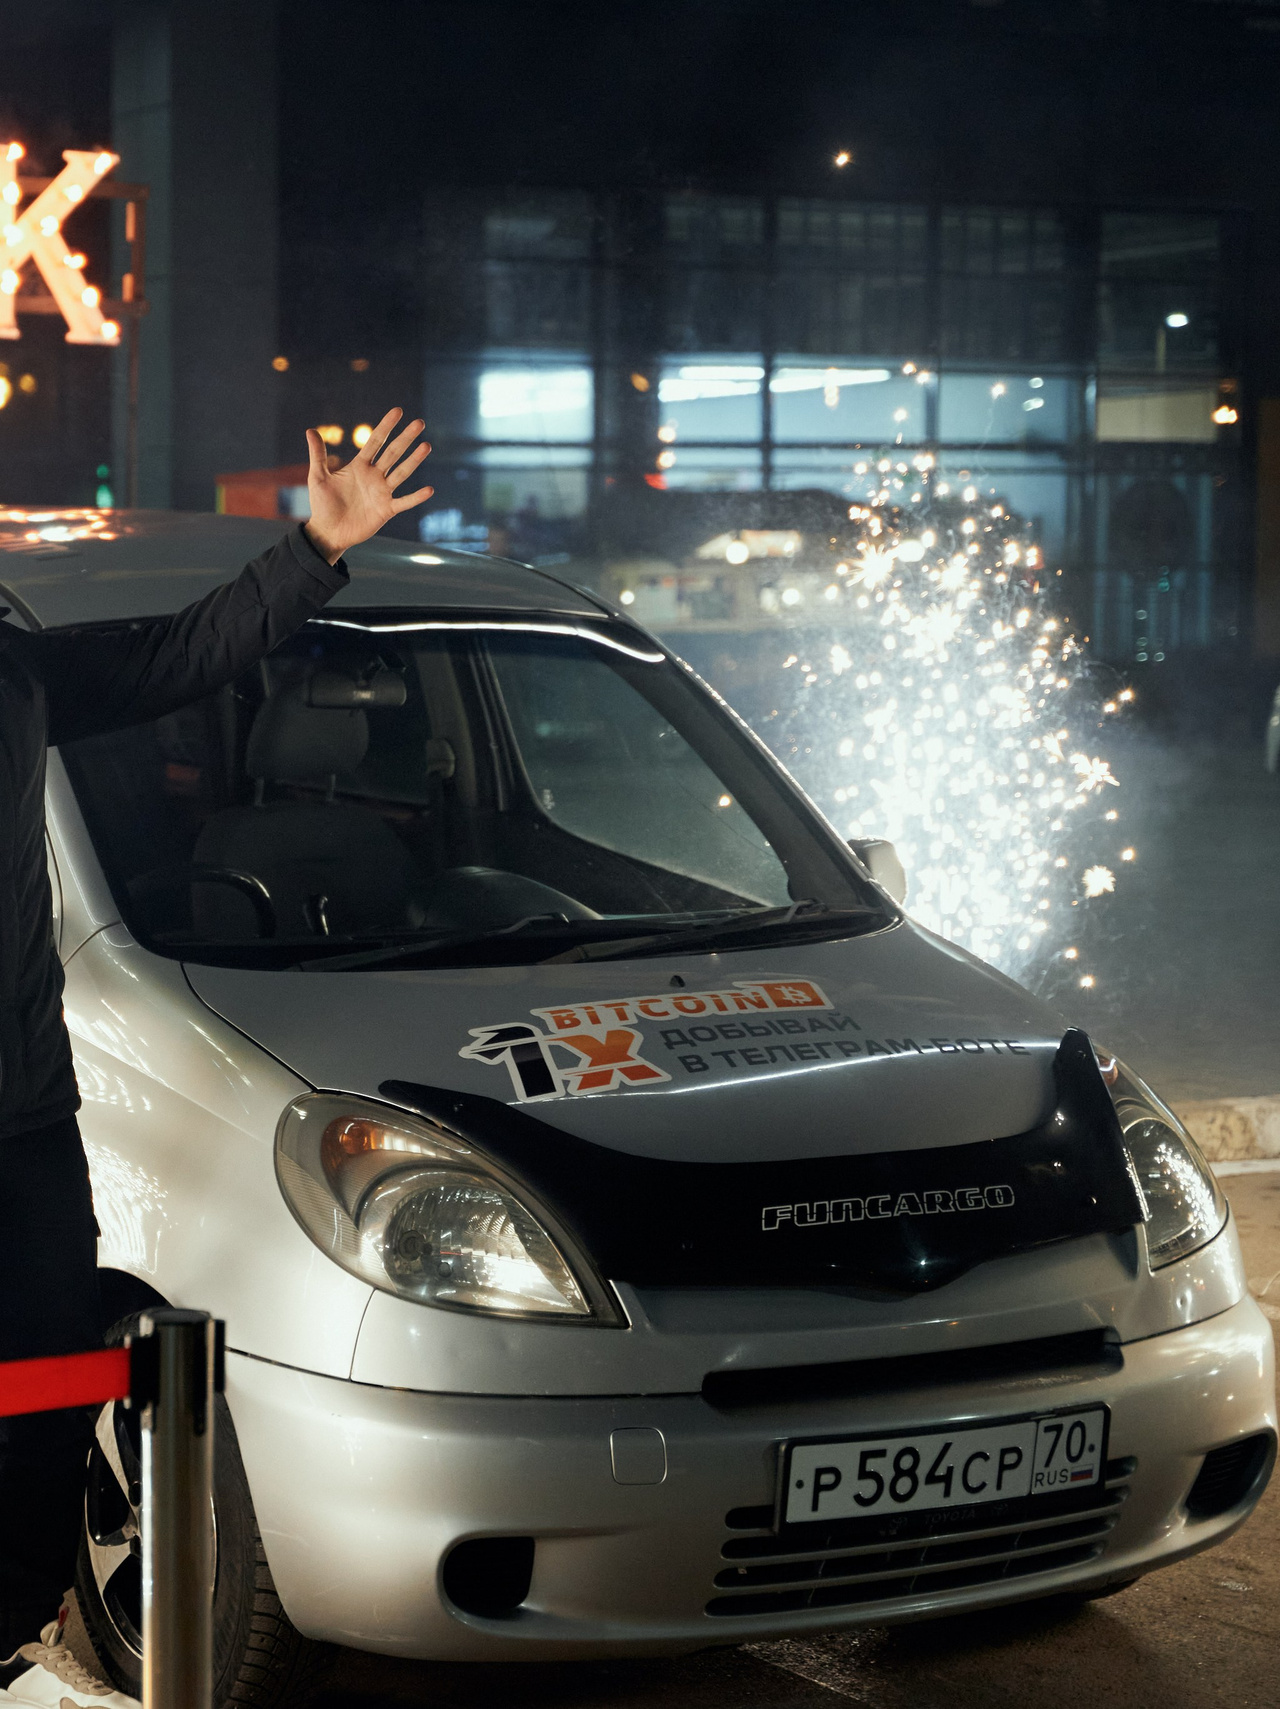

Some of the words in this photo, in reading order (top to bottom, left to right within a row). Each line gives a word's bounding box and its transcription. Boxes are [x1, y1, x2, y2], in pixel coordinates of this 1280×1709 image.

[542, 991, 765, 1031] BITCOIN
[658, 1012, 862, 1051] ДОБЫВАЙ
[677, 1053, 711, 1075] В
[711, 1037, 1033, 1069] ТЕЛЕГРАМ-БОТЕ
[761, 1185, 1015, 1231] FUNCARGO
[1042, 1420, 1088, 1469] 70
[1033, 1469, 1069, 1489] RUS
